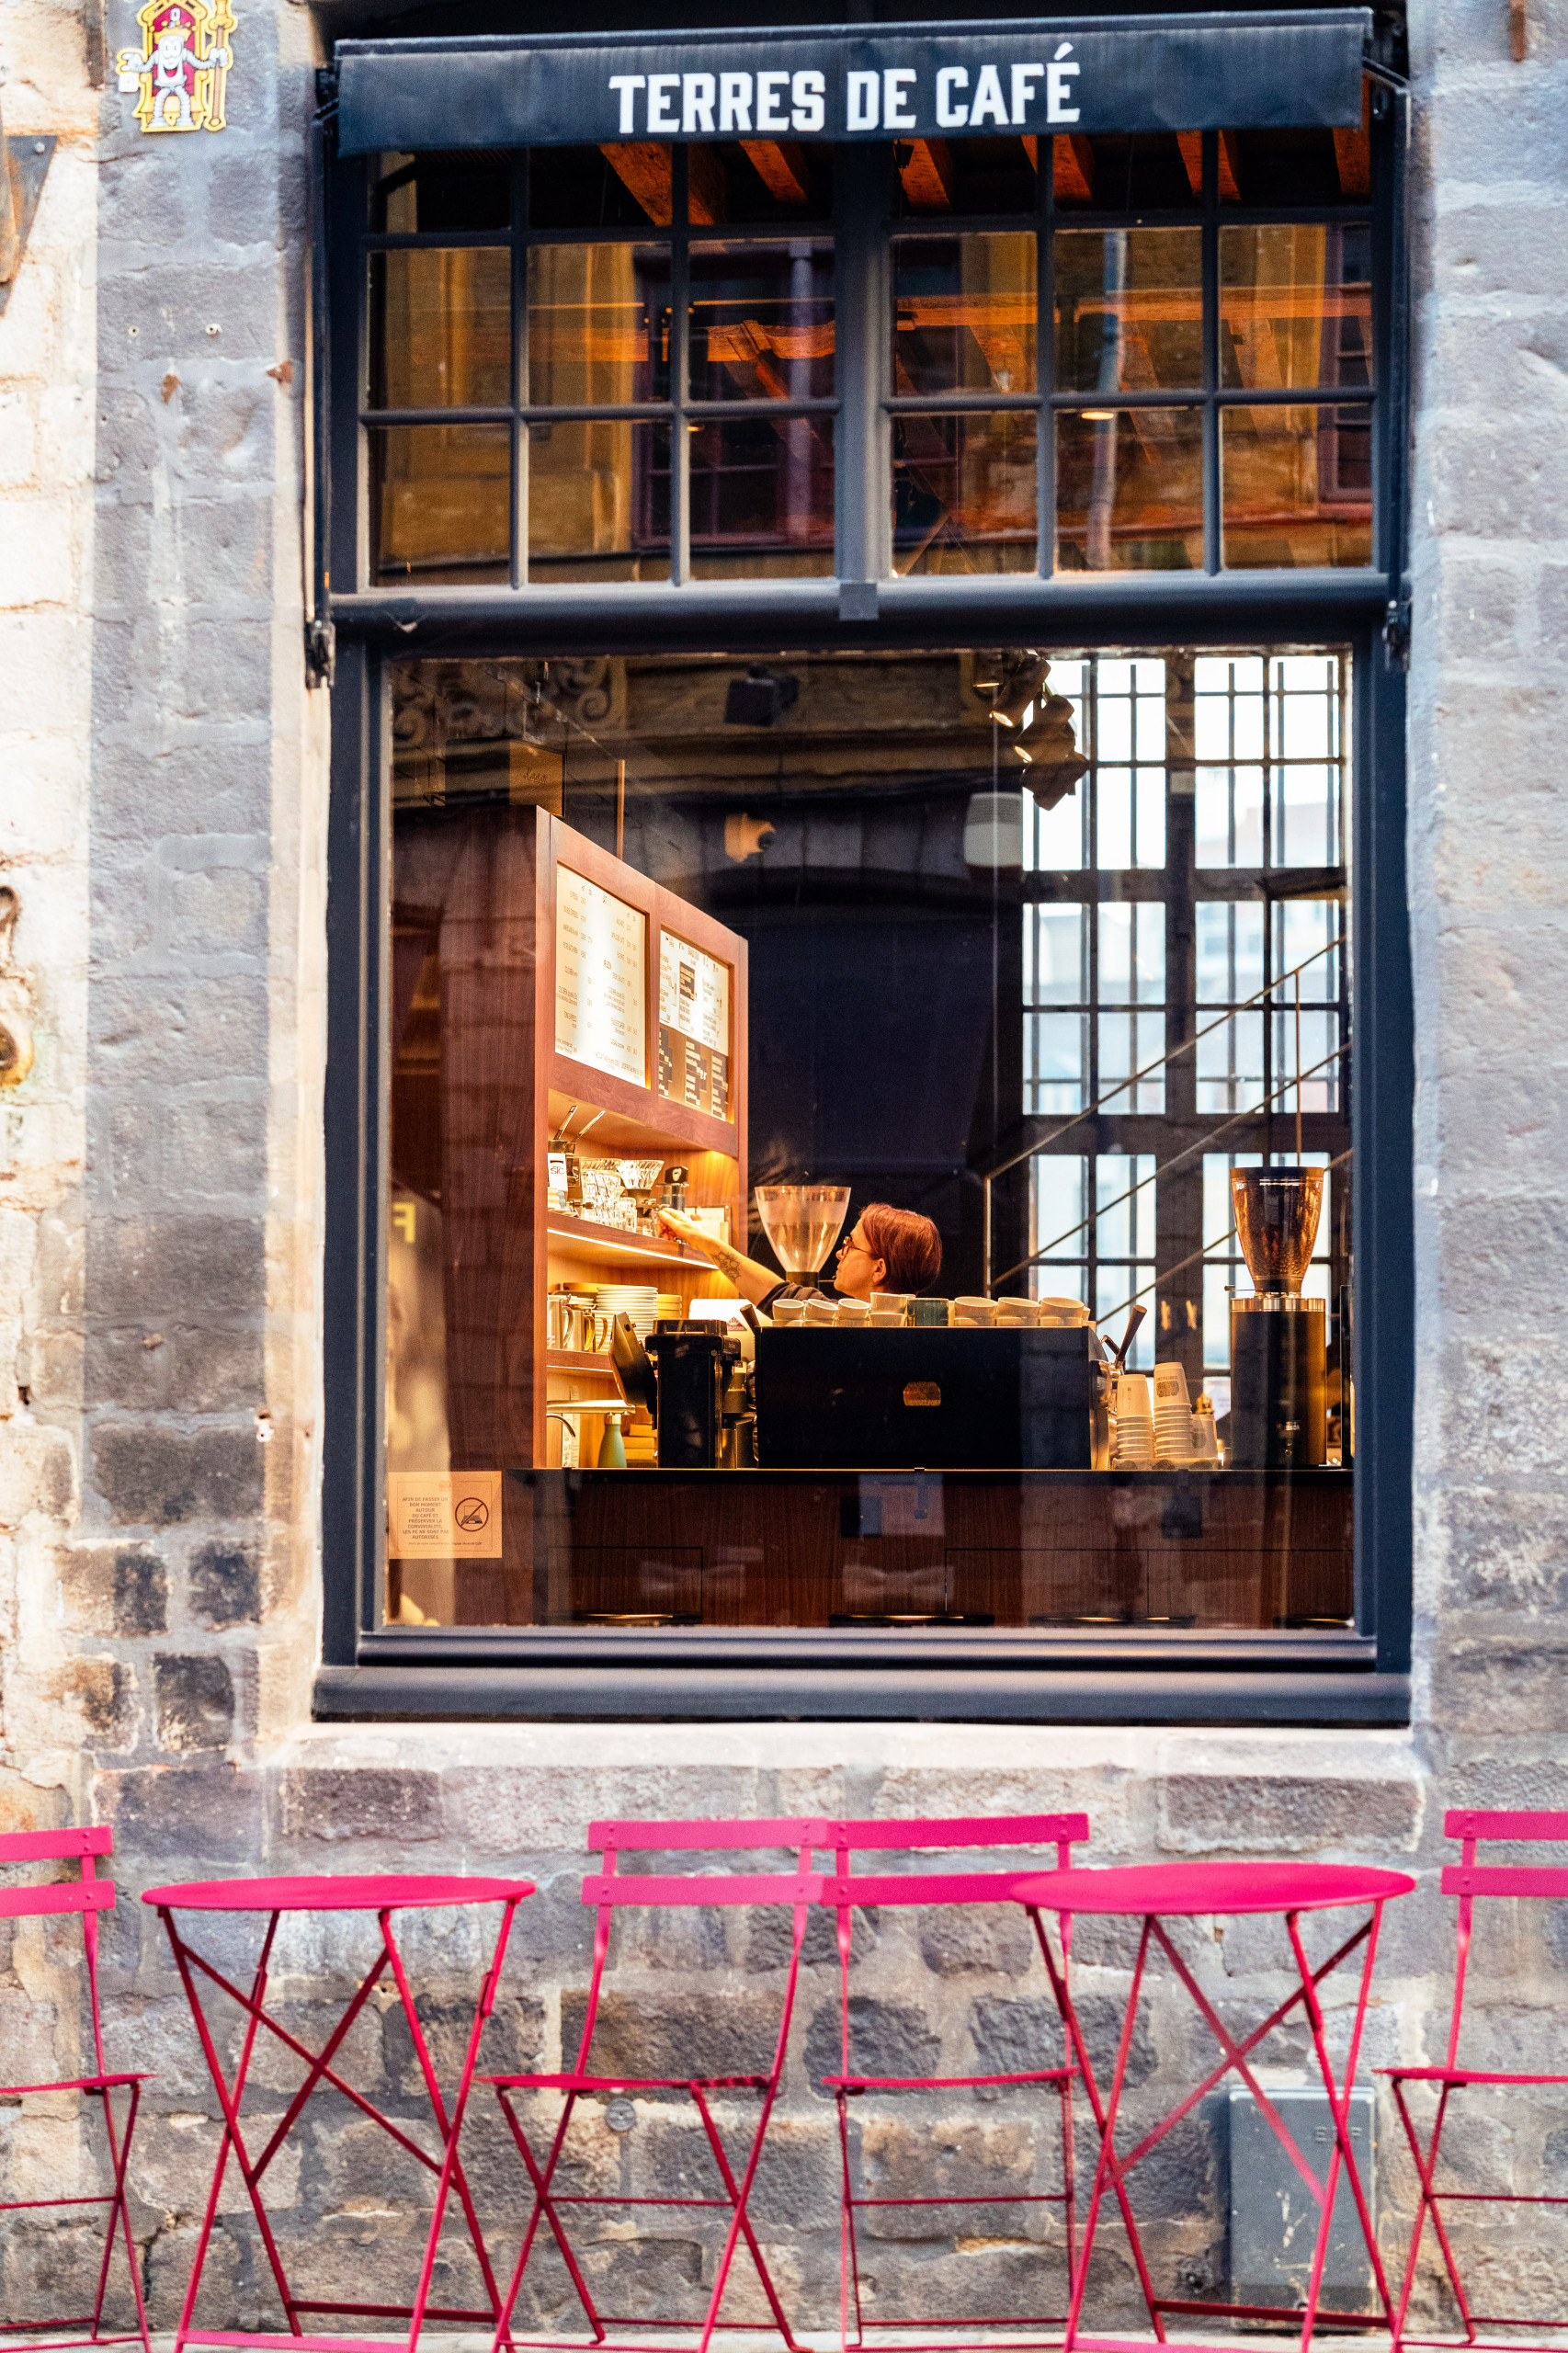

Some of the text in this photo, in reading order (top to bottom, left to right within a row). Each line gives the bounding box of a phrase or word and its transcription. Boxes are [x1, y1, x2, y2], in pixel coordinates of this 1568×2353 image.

[608, 41, 1081, 134] TERRES DE CAFÉ
